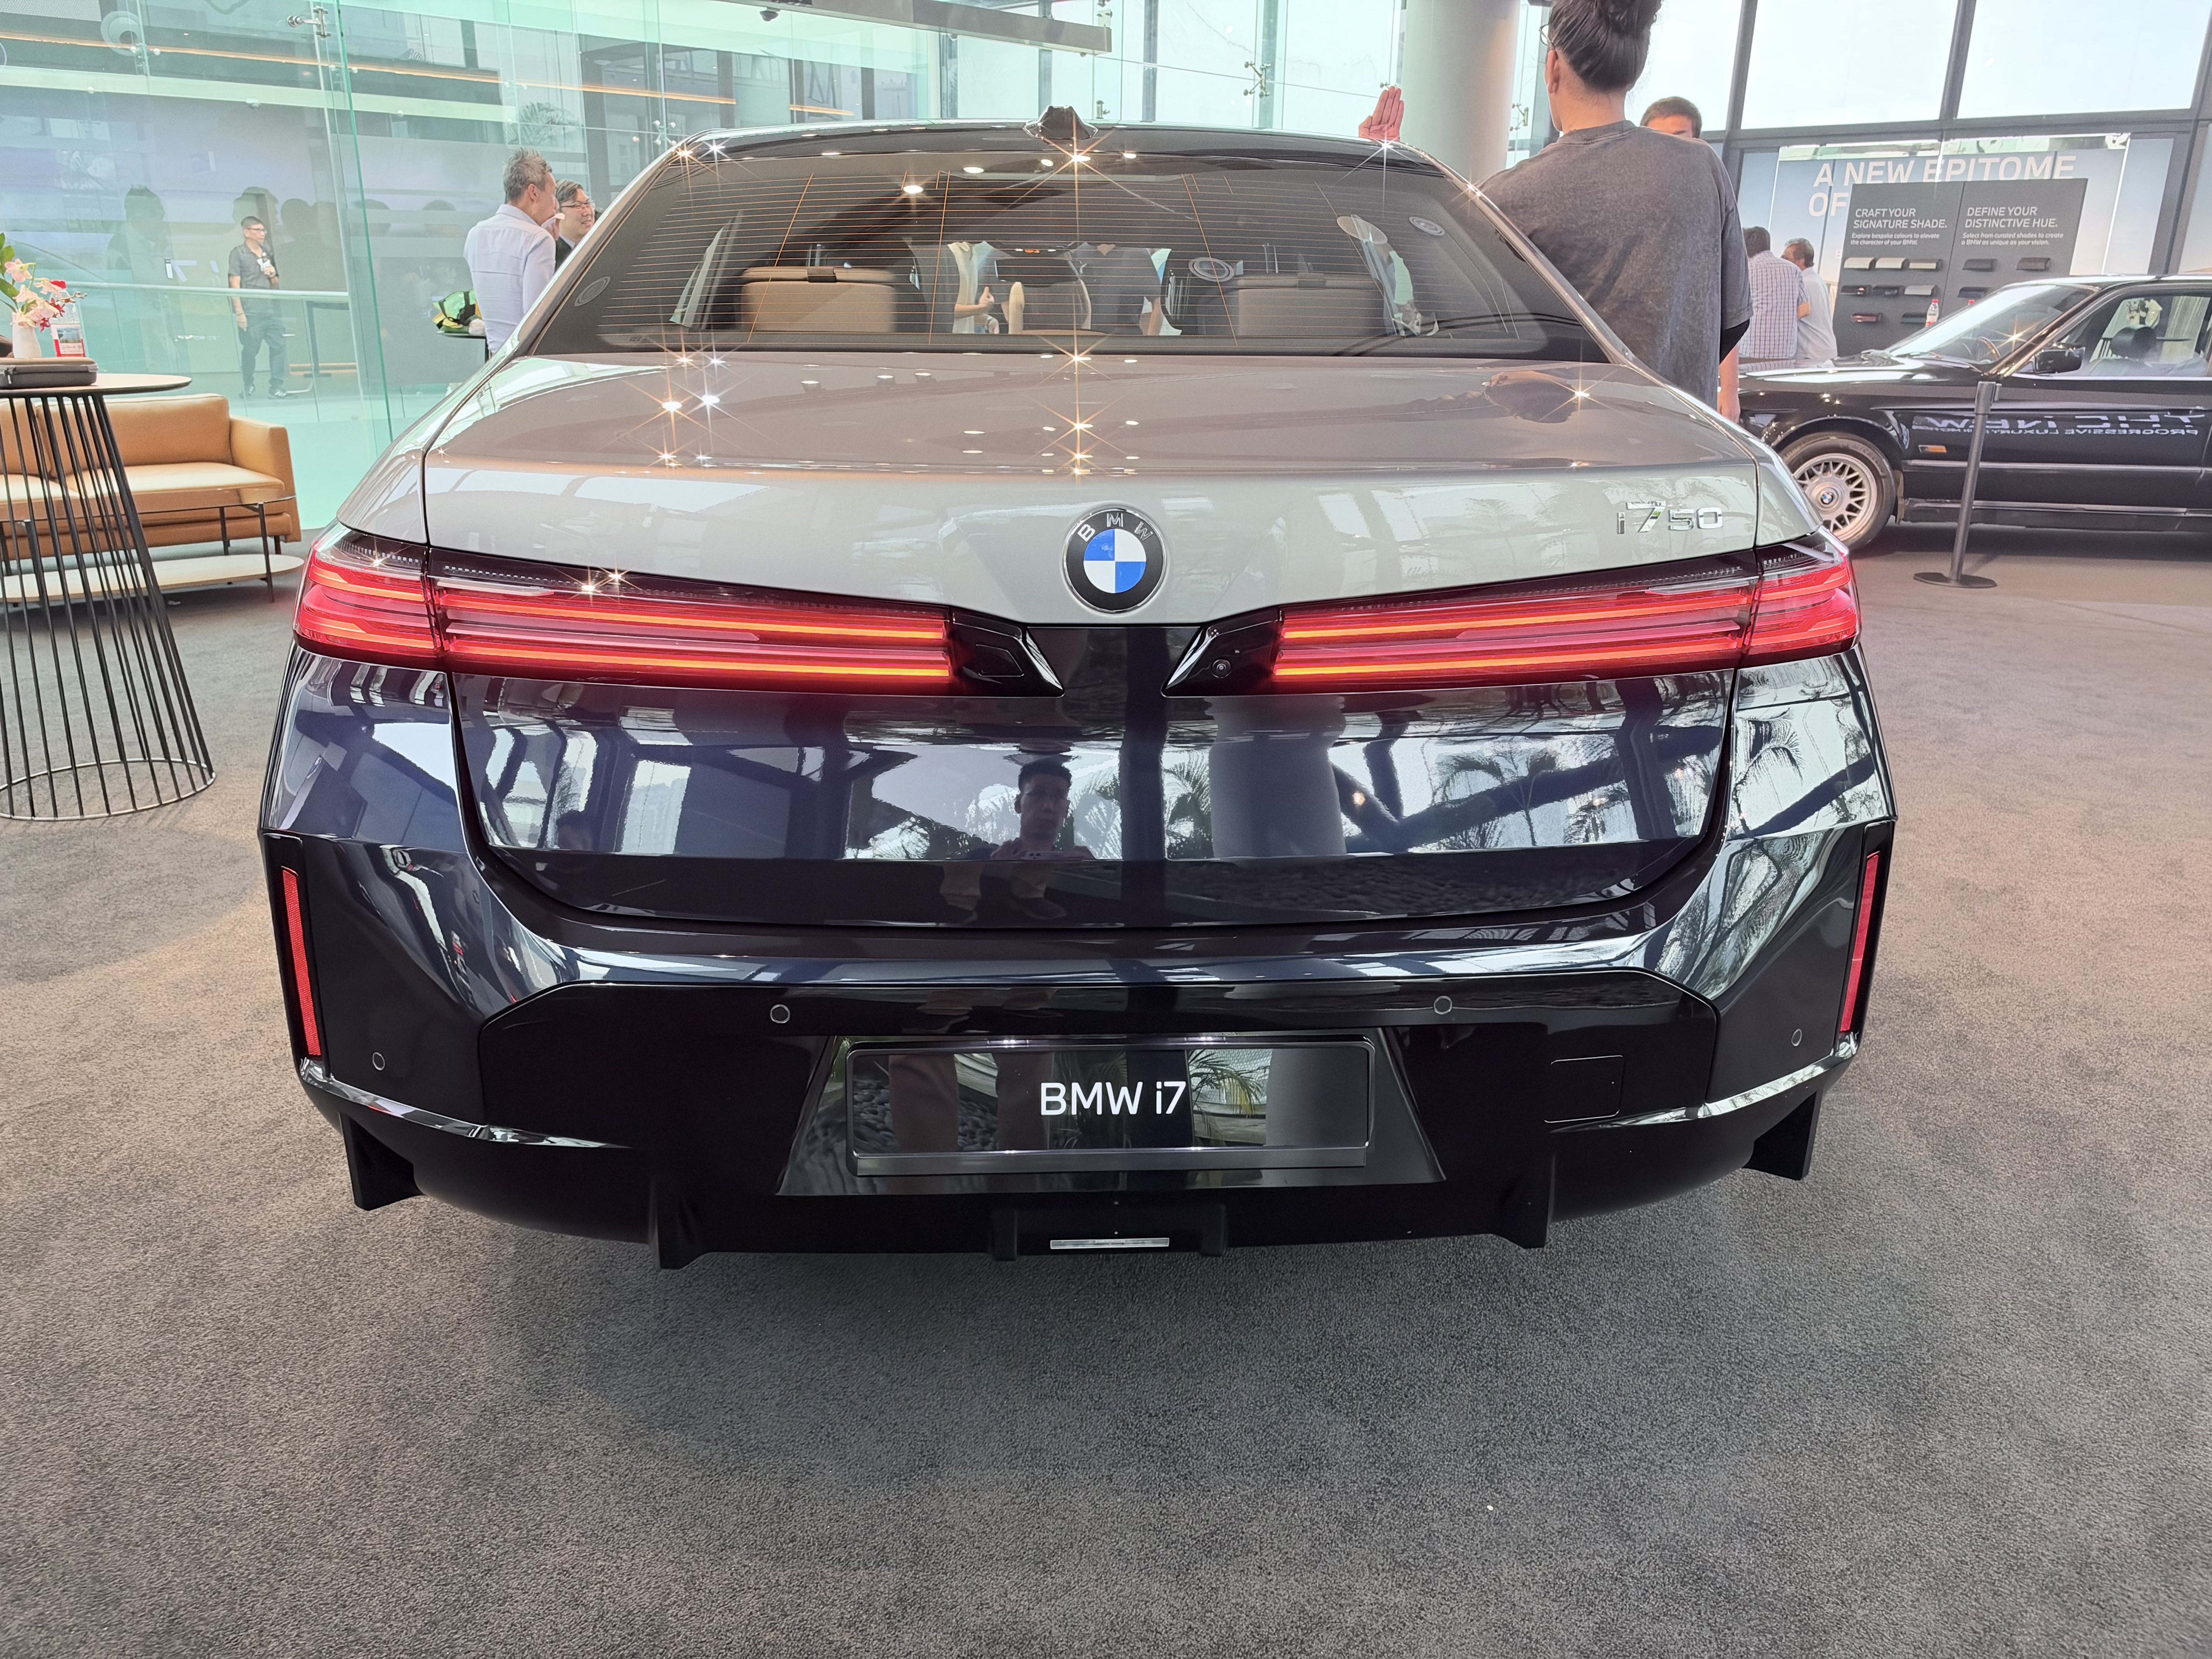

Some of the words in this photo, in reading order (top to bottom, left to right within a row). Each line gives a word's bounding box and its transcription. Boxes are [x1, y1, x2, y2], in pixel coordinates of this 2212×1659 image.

[1813, 163, 1833, 187] A
[1844, 160, 1915, 186] NEW
[1923, 156, 2076, 182] EPITOME
[1809, 192, 1849, 217] OF
[1855, 208, 1887, 217] CRAFT
[1888, 208, 1916, 217] YOUR
[1967, 207, 2006, 216] DEFINE
[2008, 206, 2037, 216] YOUR
[1853, 219, 1908, 228] SIGNATURE
[1910, 219, 1947, 228] SHADE.
[1965, 218, 2031, 228] DISTINCTIVE
[2032, 218, 2057, 228] HUE.
[1077, 513, 1153, 542] BMW
[1617, 501, 1722, 534] i750
[1041, 1082, 1143, 1115] BMW
[1156, 1081, 1186, 1114] i7
